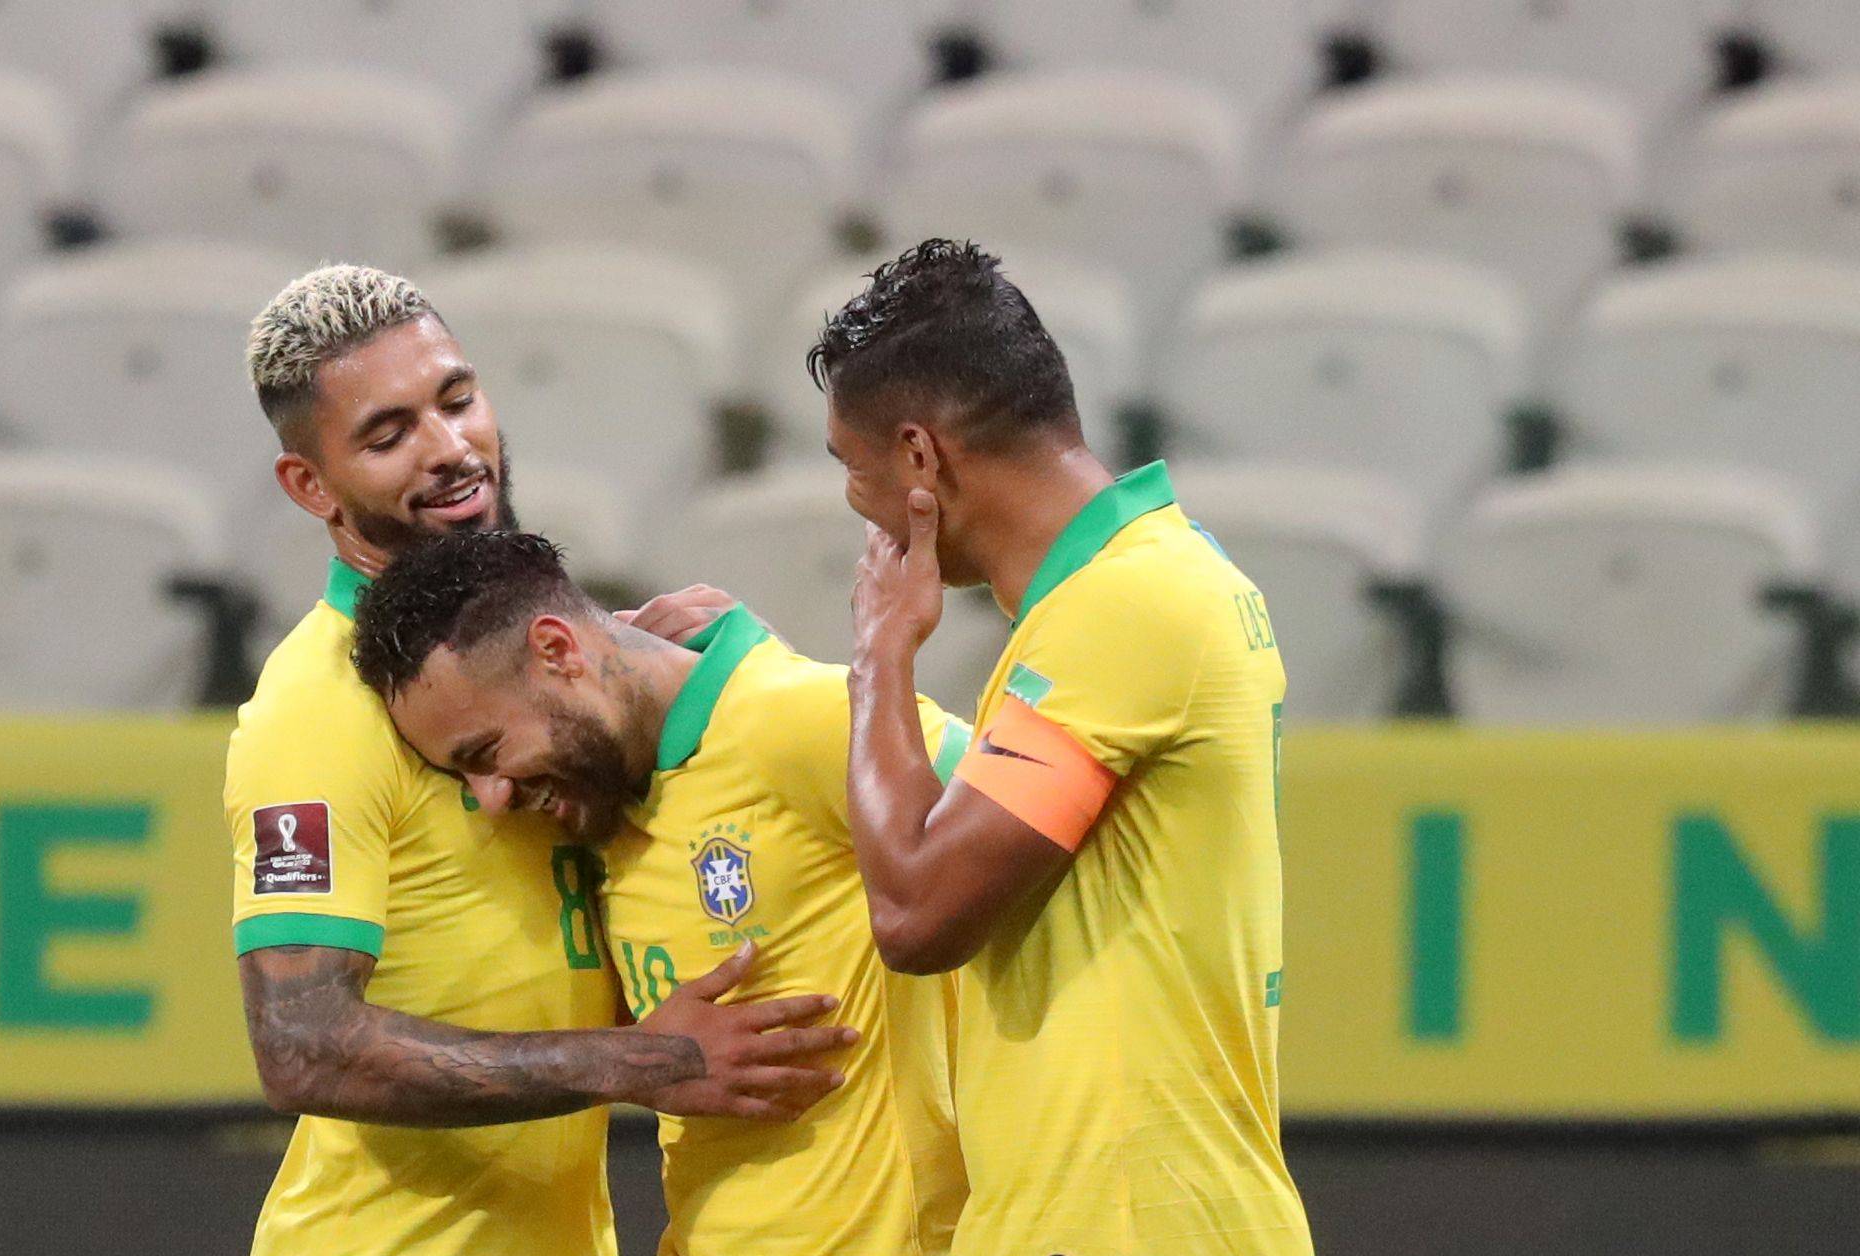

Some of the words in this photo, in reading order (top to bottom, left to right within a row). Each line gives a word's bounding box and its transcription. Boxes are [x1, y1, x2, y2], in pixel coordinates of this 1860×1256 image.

[1234, 591, 1276, 651] CAS
[266, 871, 317, 884] Qualifiers
[714, 875, 732, 886] CBF
[551, 845, 604, 969] 8
